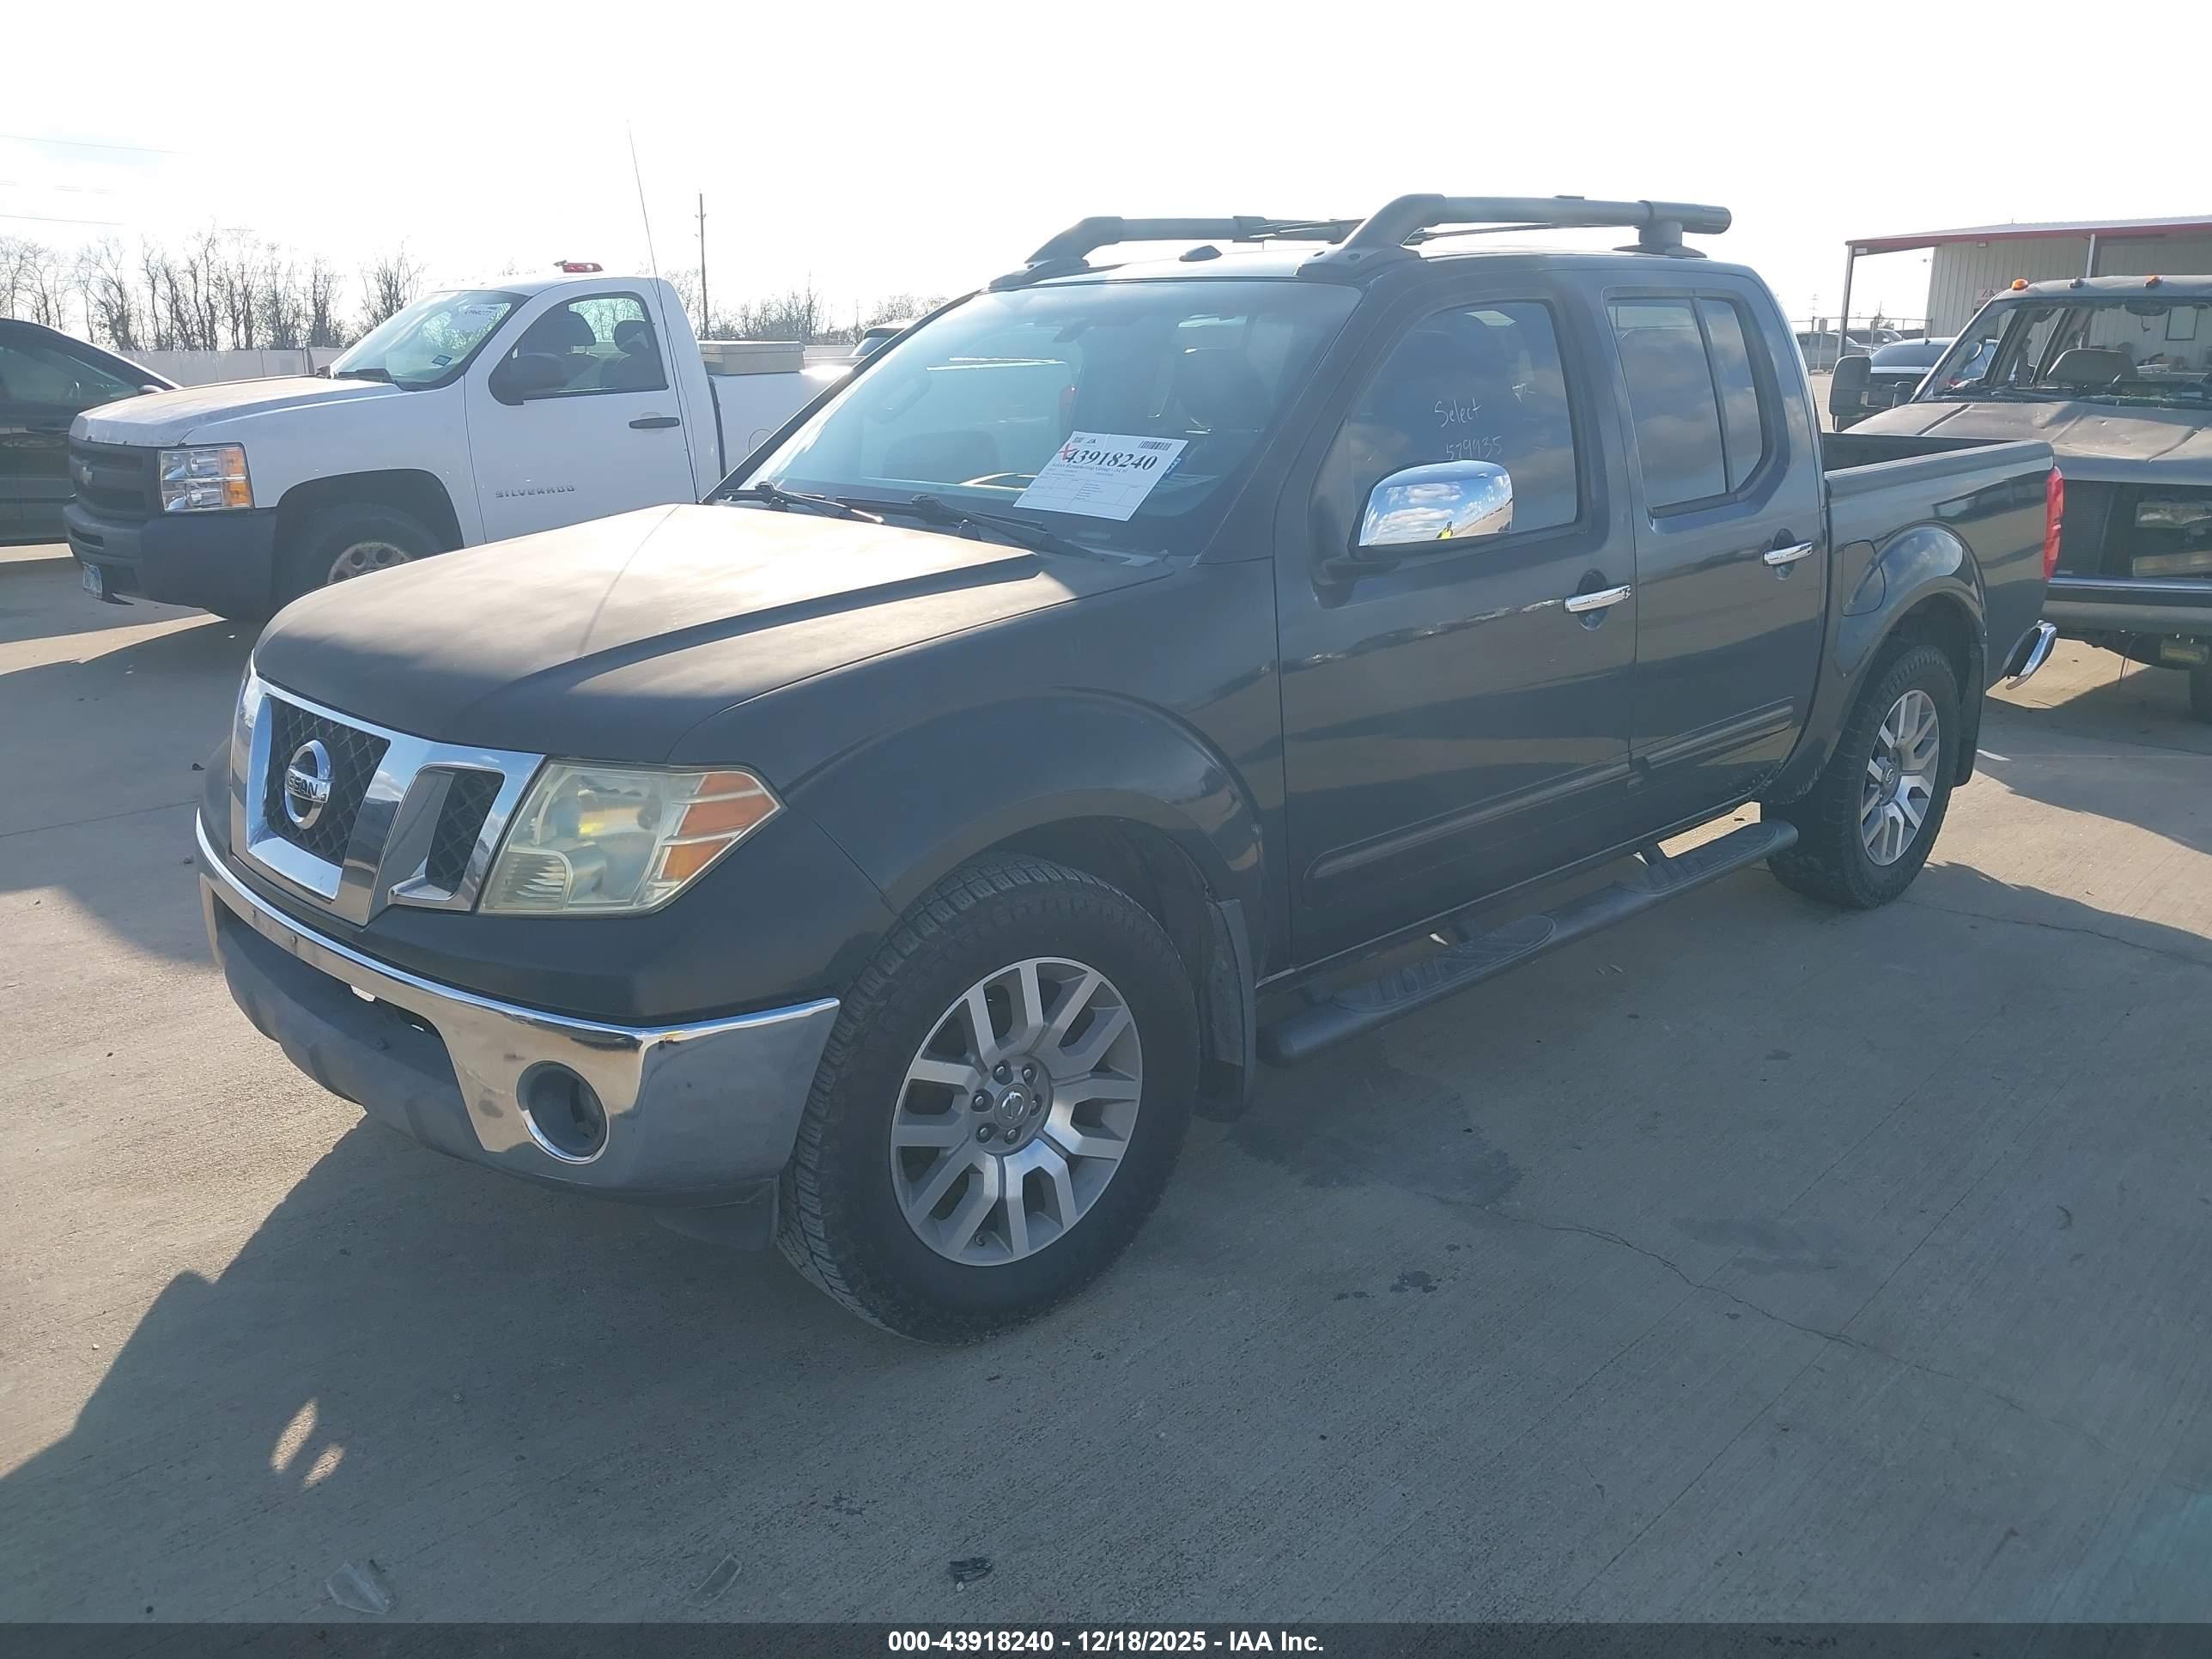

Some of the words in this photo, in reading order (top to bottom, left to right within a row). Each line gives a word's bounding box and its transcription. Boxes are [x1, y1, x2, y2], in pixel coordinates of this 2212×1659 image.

[1434, 398, 1482, 428] Select
[1065, 449, 1158, 471] 43918240
[495, 485, 575, 498] SILVERADO
